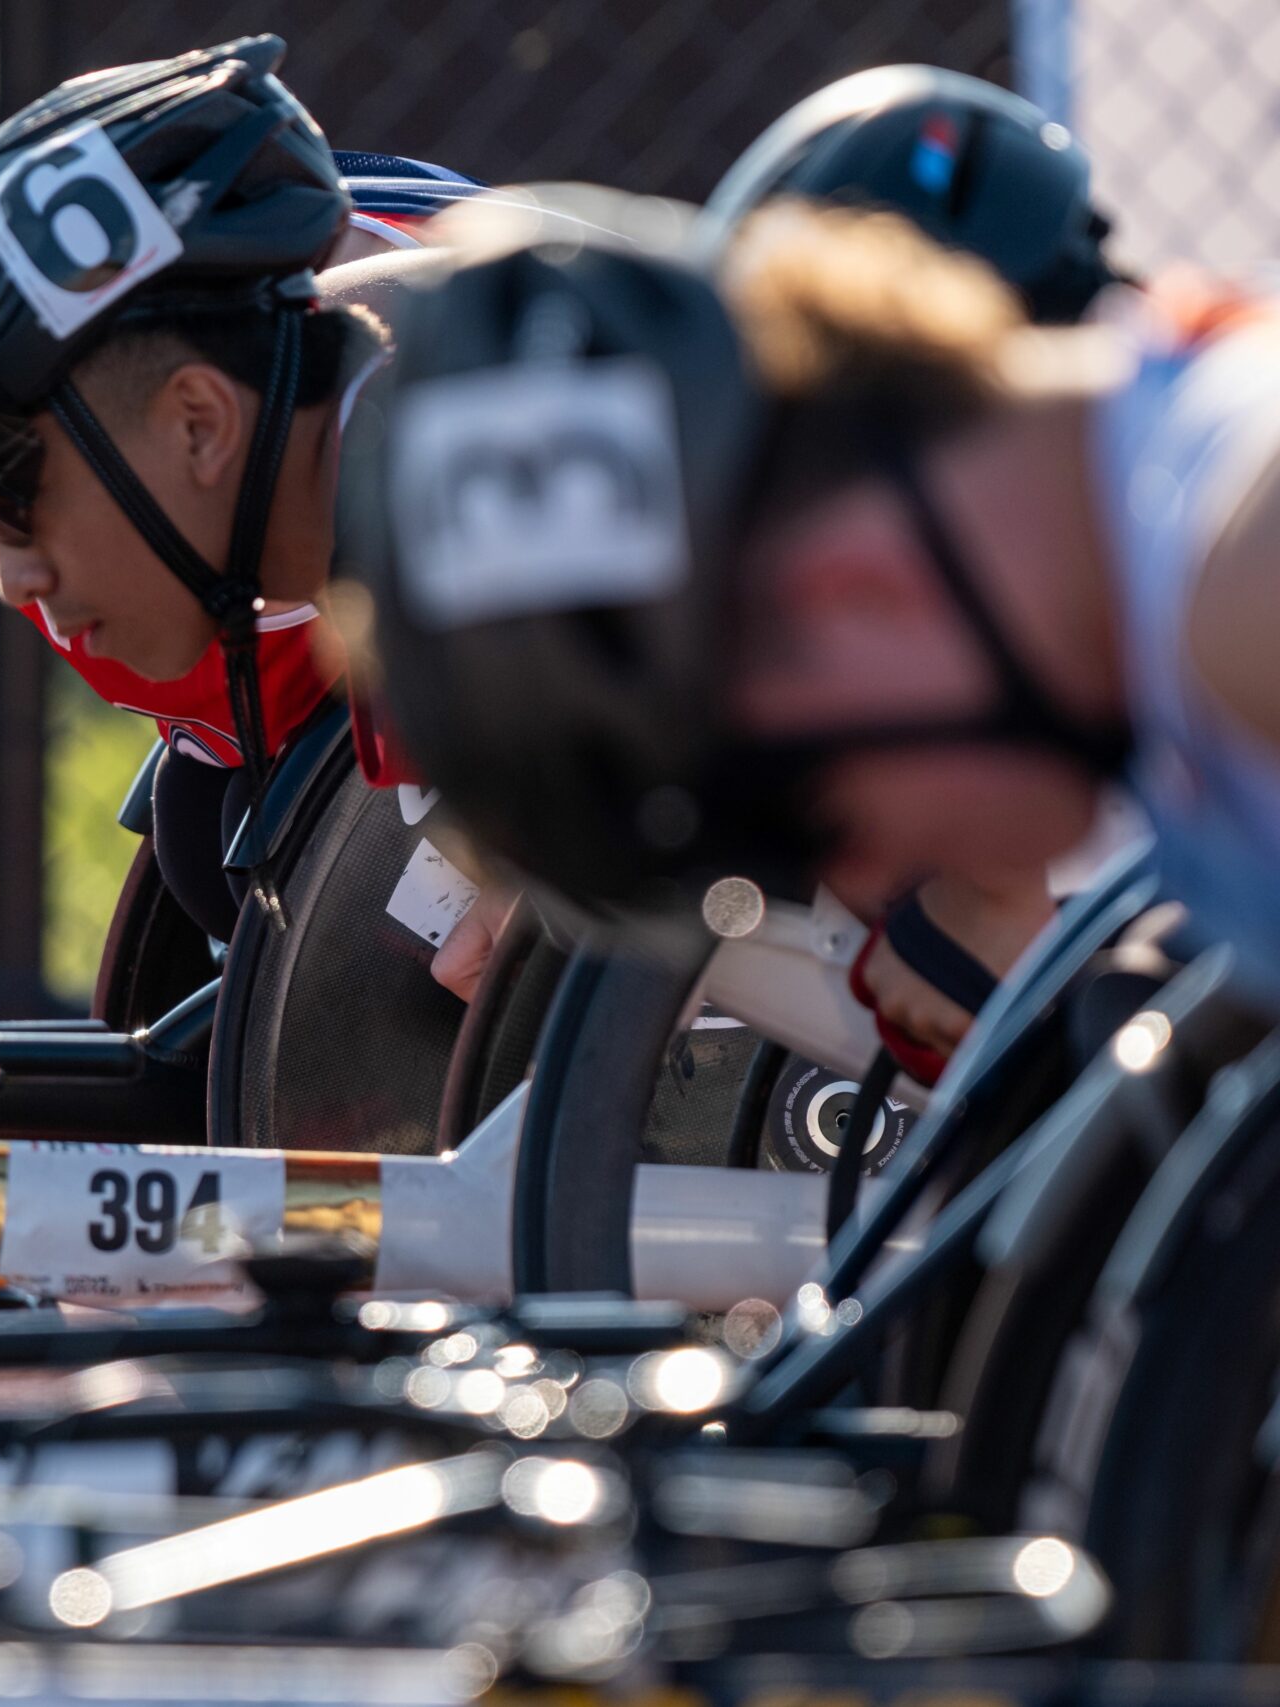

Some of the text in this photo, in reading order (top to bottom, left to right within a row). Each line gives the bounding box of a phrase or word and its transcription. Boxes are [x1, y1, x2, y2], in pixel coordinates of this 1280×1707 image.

[0, 145, 138, 292] 6
[878, 1145, 898, 1168] FRANCE
[89, 1168, 225, 1255] 394
